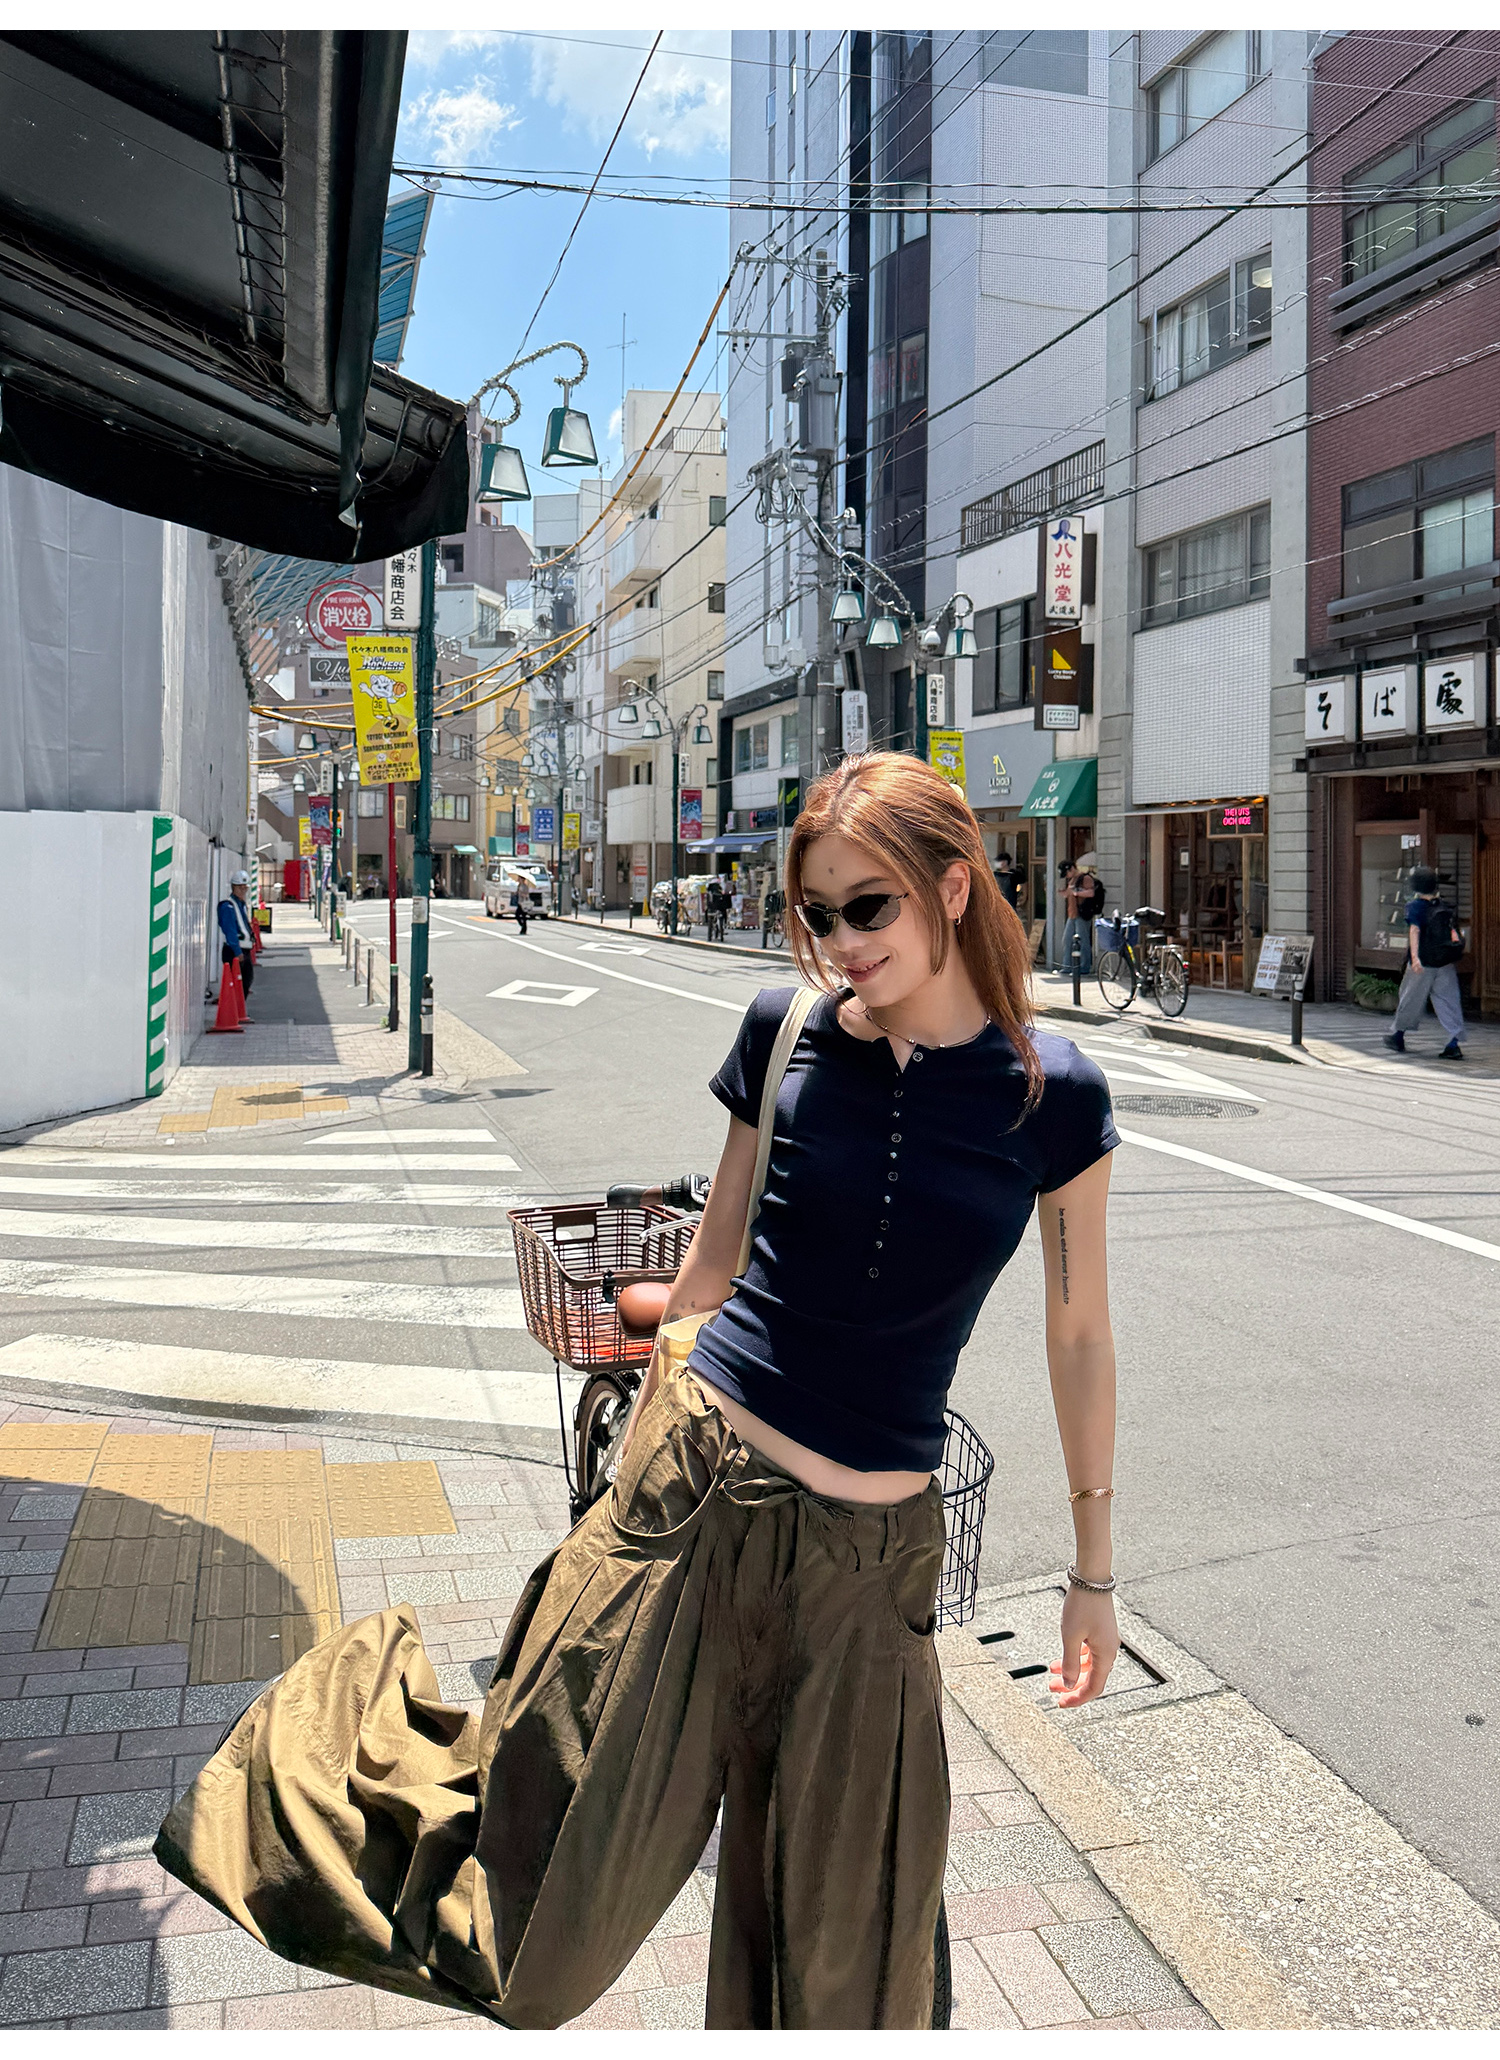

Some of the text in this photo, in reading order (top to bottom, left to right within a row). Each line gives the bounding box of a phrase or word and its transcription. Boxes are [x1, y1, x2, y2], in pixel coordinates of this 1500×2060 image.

[407, 548, 417, 573] 々木
[1055, 543, 1072, 602] 八光堂
[390, 552, 405, 621] 幡商店会
[323, 606, 369, 627] 消火栓
[1049, 605, 1075, 615] 武道具
[374, 701, 382, 709] 36
